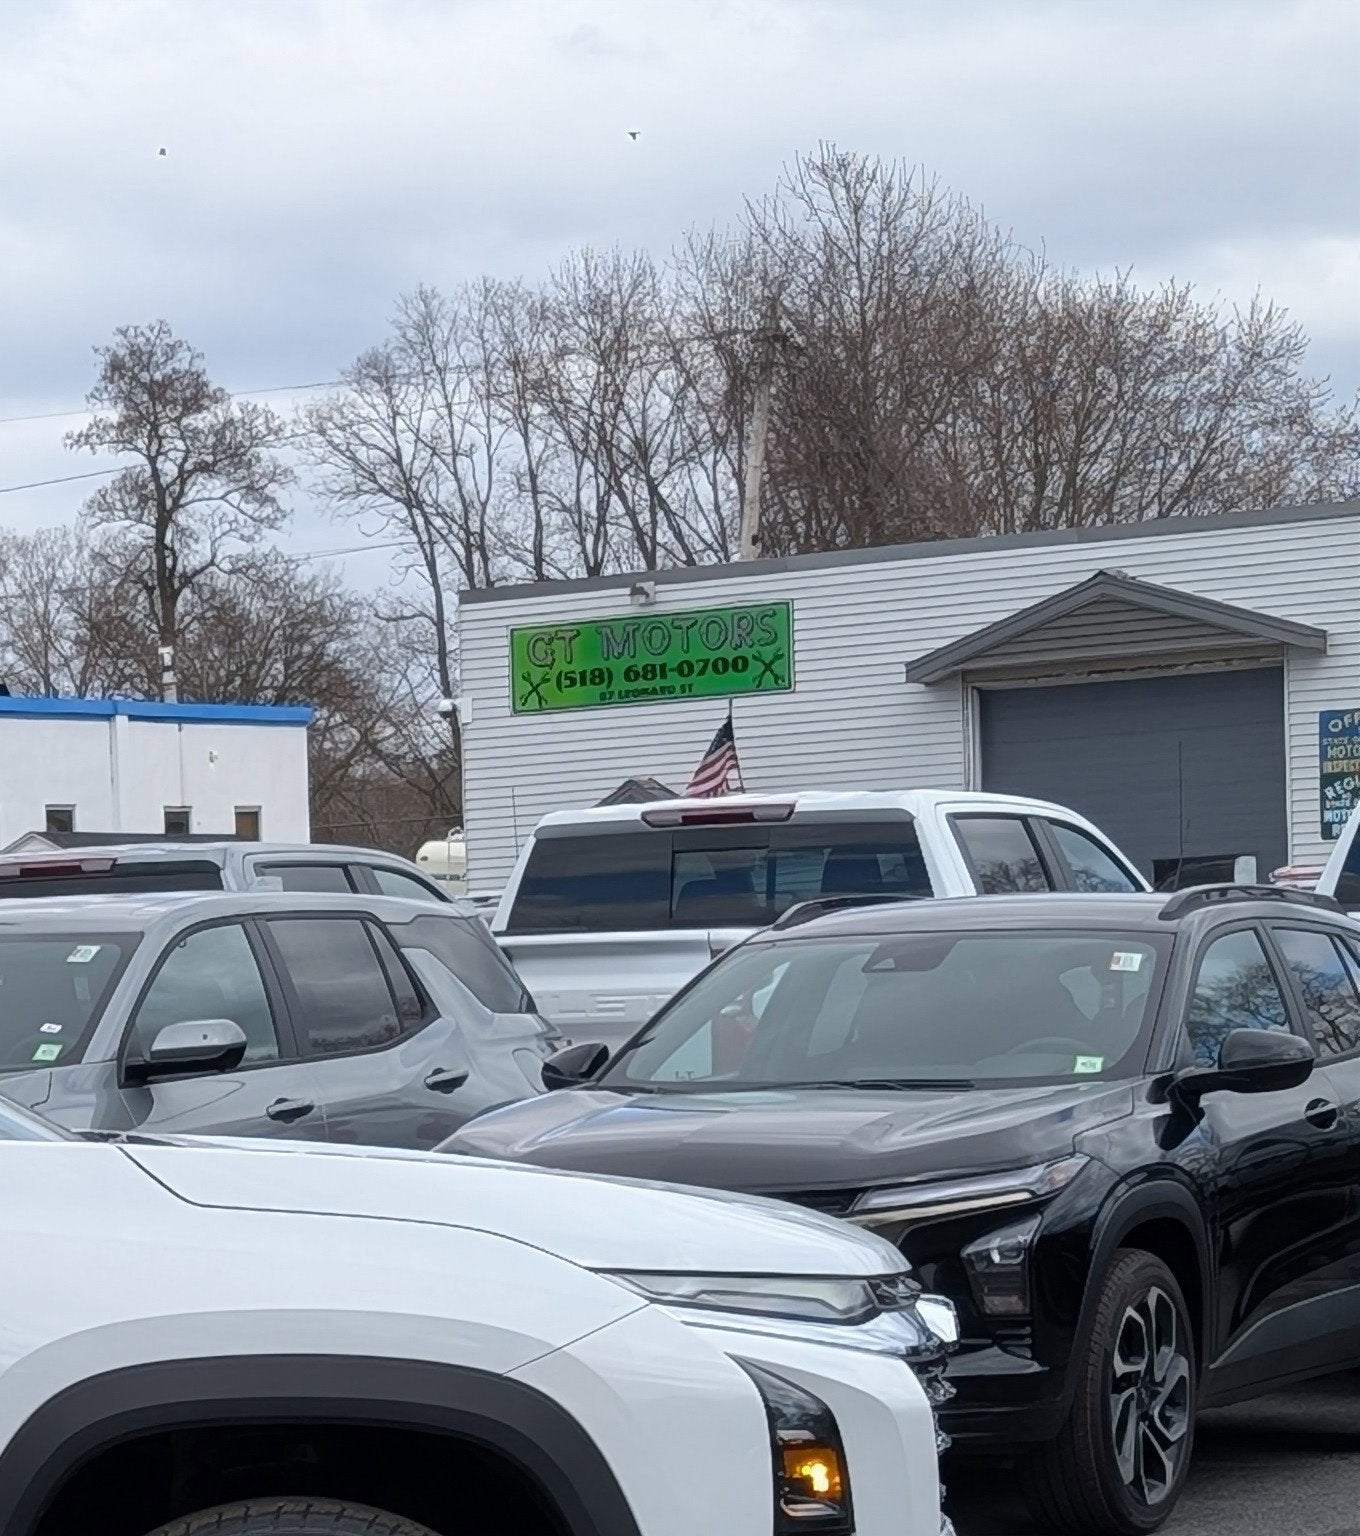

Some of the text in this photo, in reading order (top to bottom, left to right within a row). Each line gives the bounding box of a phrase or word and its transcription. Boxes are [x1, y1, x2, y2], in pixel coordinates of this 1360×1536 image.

[527, 609, 778, 670] GT MOTORS
[556, 655, 749, 693] (518) 681-0700
